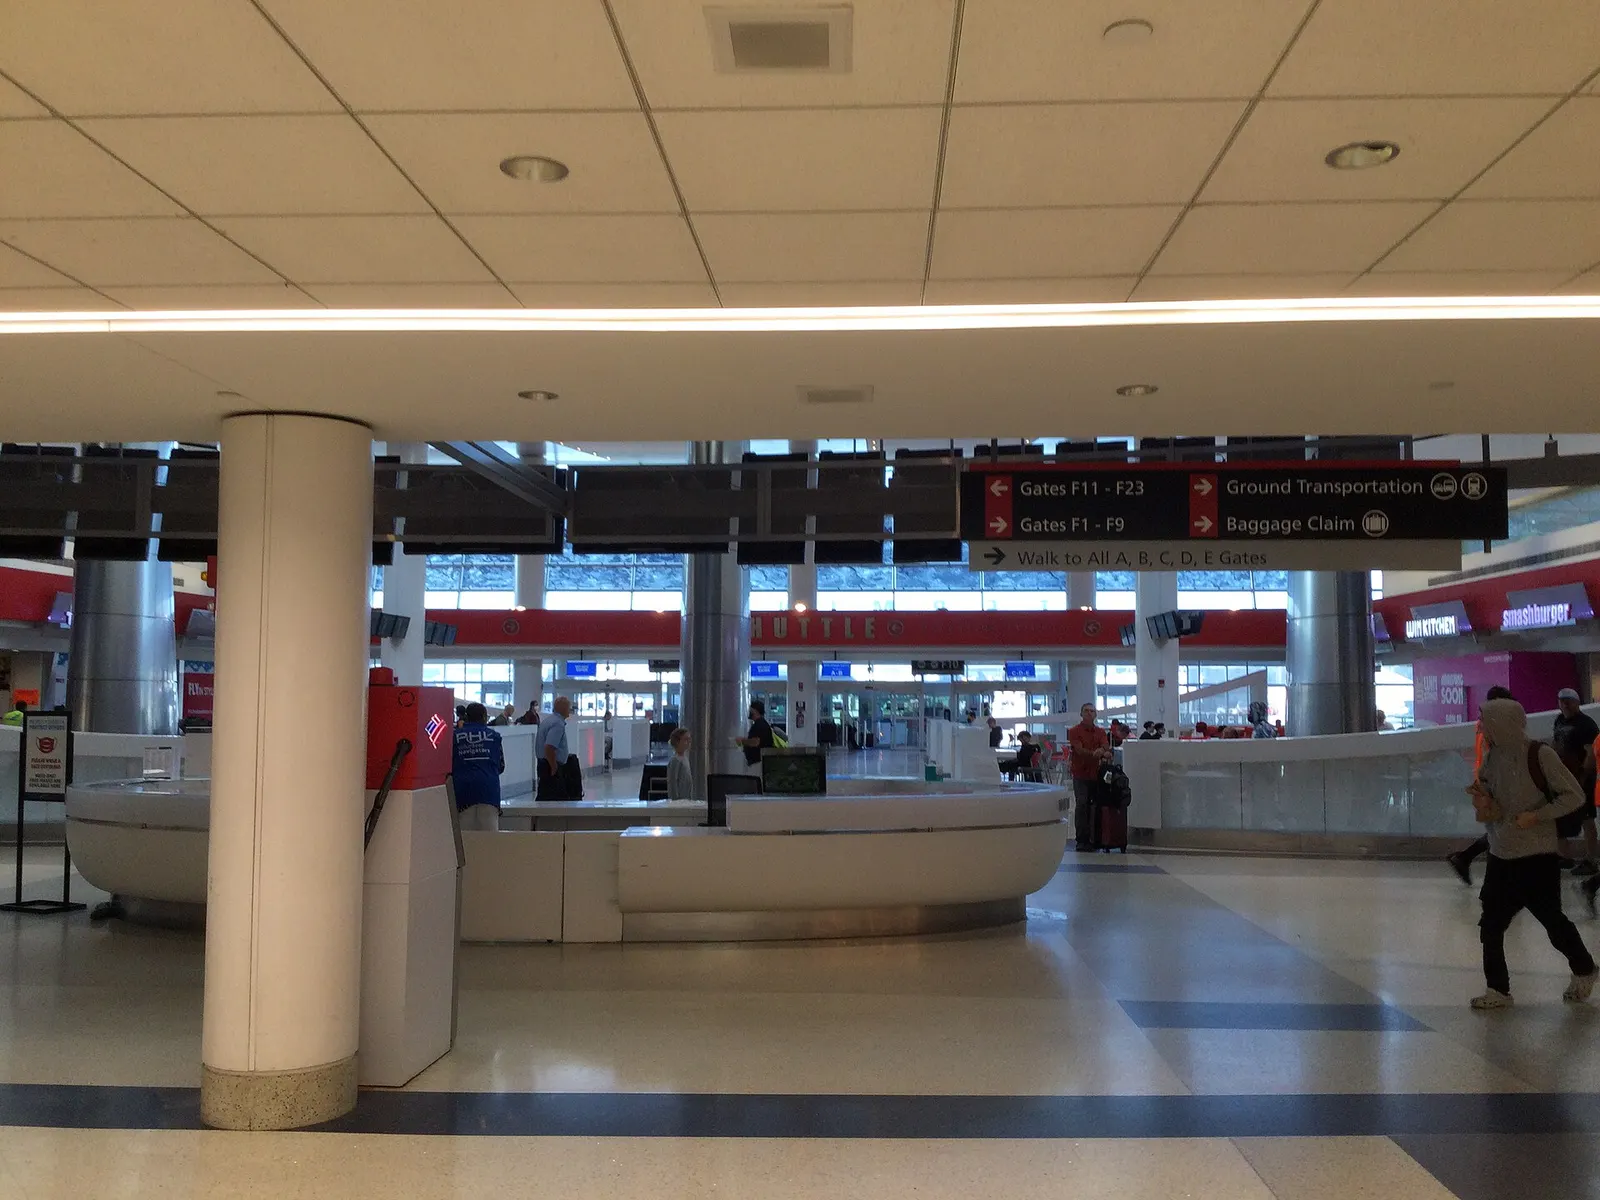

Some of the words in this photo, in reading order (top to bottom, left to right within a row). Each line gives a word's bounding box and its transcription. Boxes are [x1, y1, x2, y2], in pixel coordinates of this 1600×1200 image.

[1020, 481, 1067, 497] Gates
[1071, 481, 1098, 496] F11
[1115, 480, 1144, 496] F23
[1226, 479, 1291, 495] Ground
[1297, 478, 1424, 498] Transportation
[1020, 517, 1067, 533] Gates
[1071, 517, 1090, 533] F1
[1105, 517, 1125, 533] F9
[1226, 516, 1302, 535] Baggage
[1307, 515, 1355, 532] Claim
[1017, 550, 1060, 566] Walk
[1064, 552, 1082, 566] to
[1087, 550, 1110, 566] All
[1115, 551, 1132, 569] A,
[1138, 551, 1153, 569] B,
[1159, 551, 1175, 569] C,
[1181, 551, 1197, 569] D,
[1204, 551, 1214, 565] E
[1219, 550, 1268, 567] Gates
[1502, 603, 1570, 628] smashburger
[750, 616, 876, 639] HUTTLE
[1422, 615, 1456, 637] KITCHEN
[1440, 686, 1464, 705] SOON
[456, 731, 494, 744] PHL
